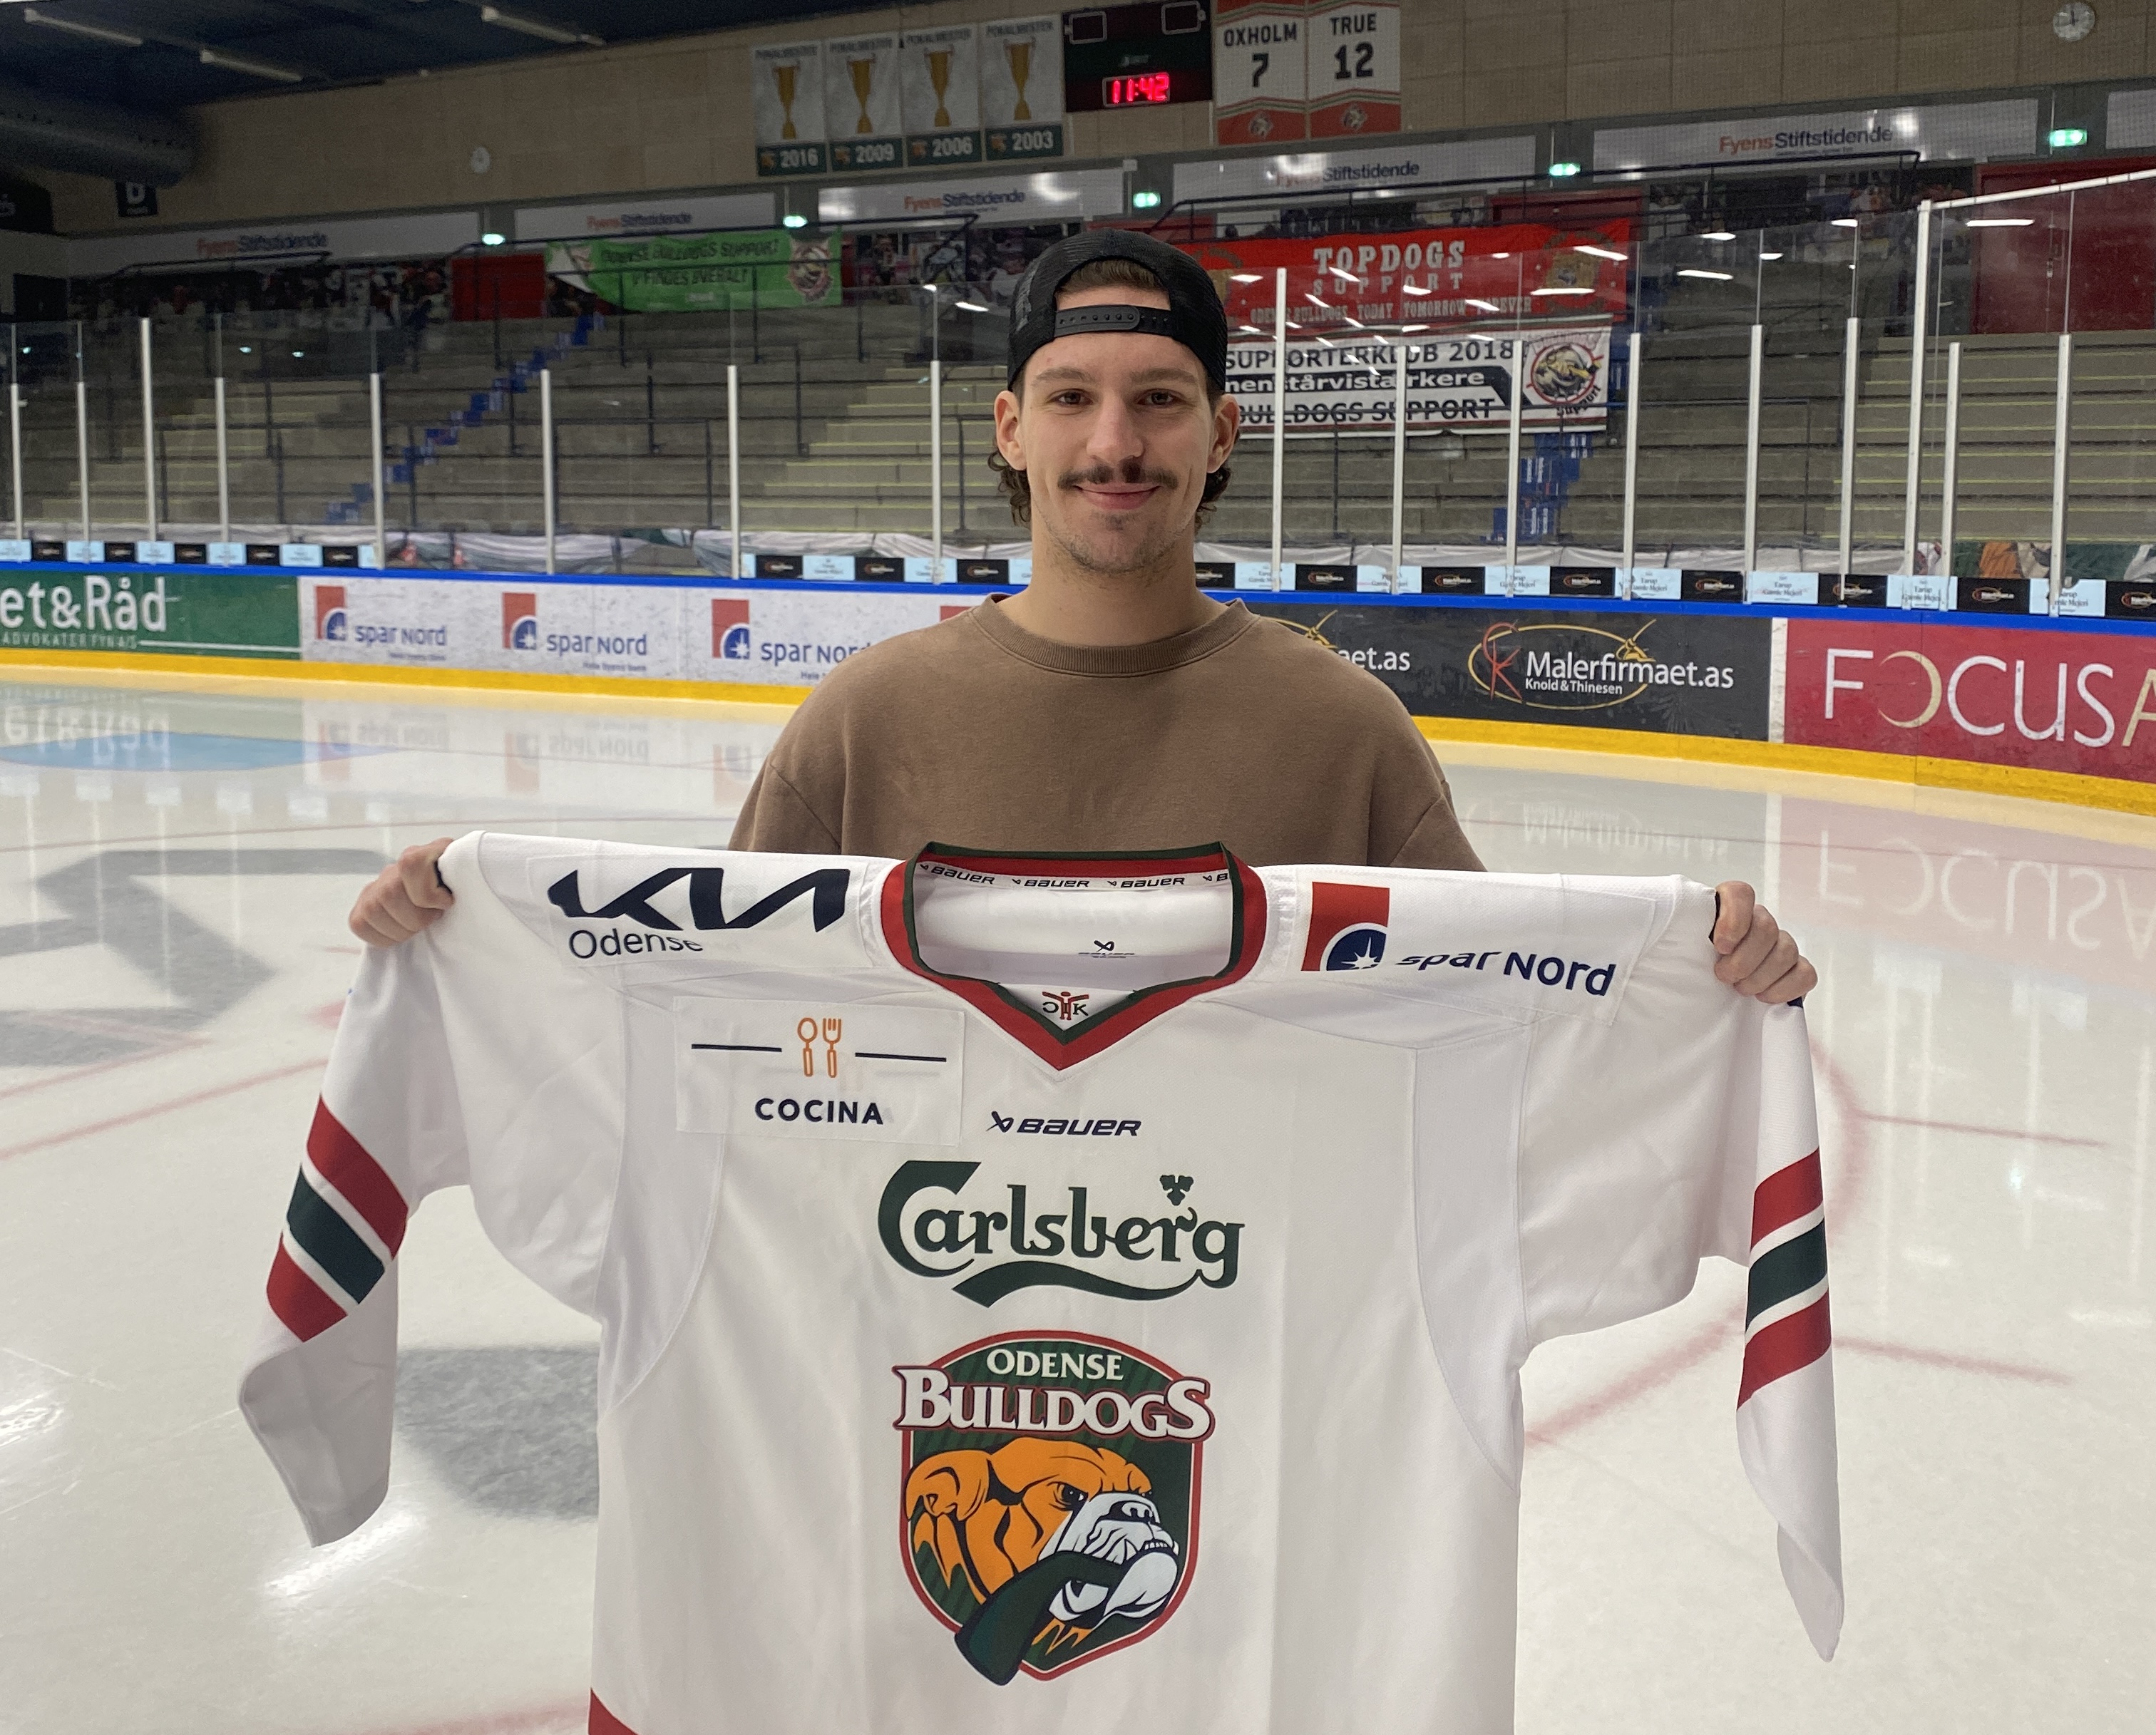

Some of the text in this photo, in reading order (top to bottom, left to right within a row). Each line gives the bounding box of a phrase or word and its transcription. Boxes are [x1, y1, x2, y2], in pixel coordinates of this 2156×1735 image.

[1223, 22, 1298, 47] OXHOLM
[1330, 12, 1377, 36] TRUE
[1251, 53, 1270, 88] 7
[1334, 41, 1375, 81] 12
[1112, 73, 1169, 103] 11:42
[932, 137, 973, 158] 2006
[1011, 130, 1054, 150] 2003
[779, 148, 818, 169] 2016
[856, 143, 895, 163] 2009
[1313, 240, 1465, 275] TOPDOGS
[1313, 272, 1464, 296] SUPPORT
[1251, 306, 1291, 324] ODENE
[1357, 302, 1393, 320] TODAY
[1403, 299, 1466, 319] TOMORROW
[1474, 296, 1531, 314] REVER
[1449, 339, 1513, 361] 2018
[1238, 402, 1363, 423] ULDOGS
[355, 624, 448, 647] spar Nord
[547, 634, 647, 657] spar Nord
[761, 642, 871, 666] spar Nor
[1526, 650, 1734, 689] Malerfirmaet.as
[1525, 678, 1559, 691] Knold
[930, 865, 995, 885] BAUER
[1024, 878, 1090, 888] BAUER
[1120, 876, 1186, 889] BAUER
[569, 928, 703, 959] Odense
[1395, 951, 1617, 997] spar Nord
[754, 1098, 884, 1126] COCINA
[1016, 1117, 1142, 1137] BAUER
[878, 1160, 1246, 1308] Carlsberg
[986, 1348, 1124, 1381] ODENSE
[893, 1366, 1214, 1442] BULLDOGS
